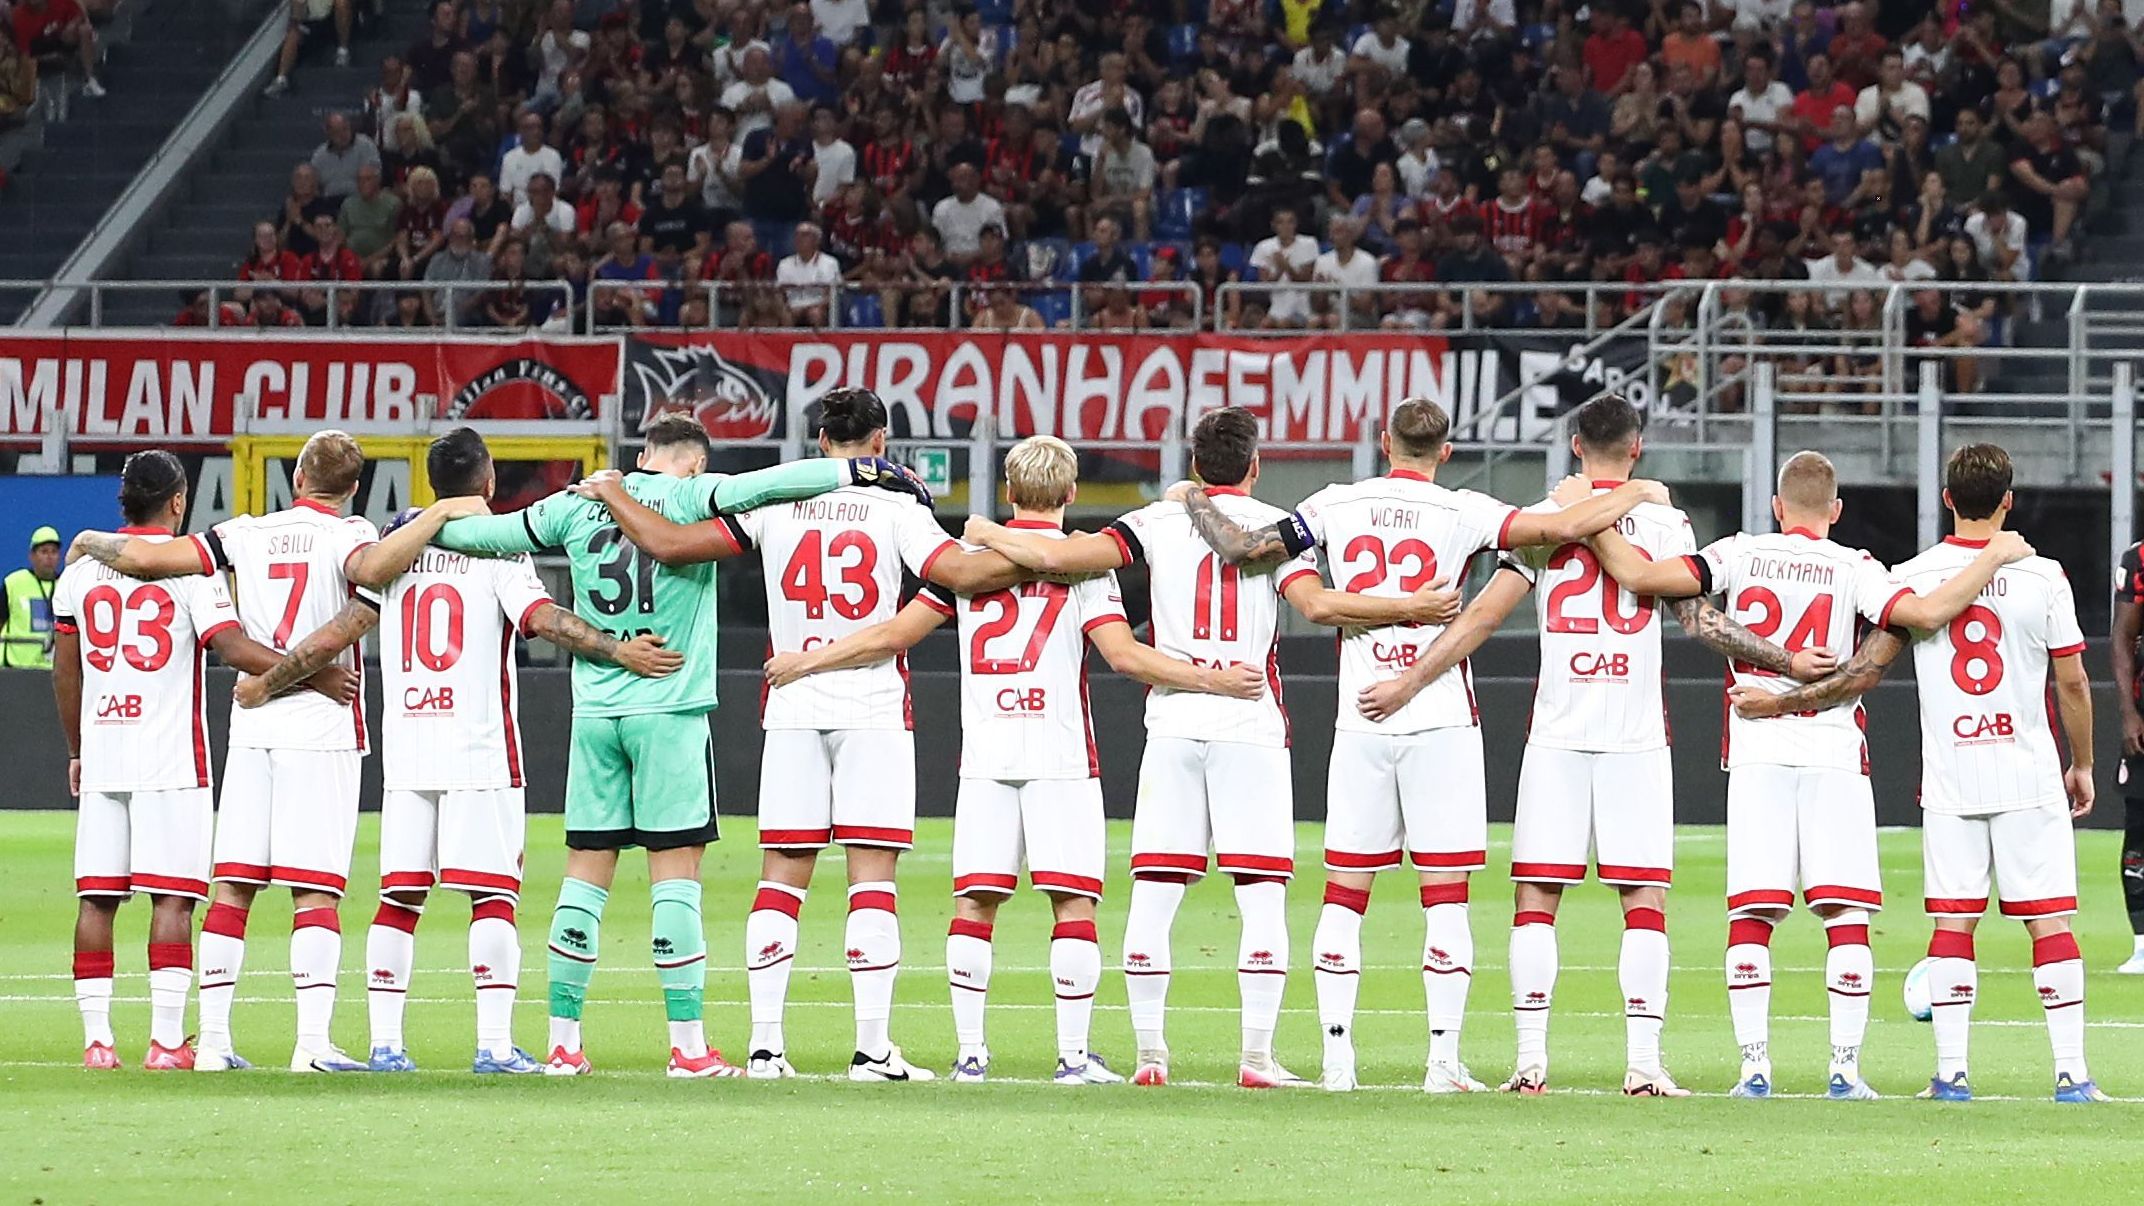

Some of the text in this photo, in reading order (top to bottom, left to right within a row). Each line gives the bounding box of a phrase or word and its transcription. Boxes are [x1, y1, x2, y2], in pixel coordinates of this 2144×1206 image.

[0, 357, 417, 434] MILAN CLUB
[792, 500, 869, 522] NIKOLAOU
[1370, 507, 1420, 530] VICARI
[267, 562, 308, 649] 7
[588, 527, 655, 615] 31
[780, 529, 879, 620] 43
[1193, 551, 1238, 641] 11
[1343, 534, 1437, 628] 23
[1547, 542, 1654, 635] 20
[1750, 556, 1834, 586] DICKMANN
[83, 583, 175, 672] 93
[401, 582, 464, 673] 10
[969, 581, 1069, 674] 27
[1372, 641, 1418, 667] CAB
[1569, 652, 1629, 676] CAB
[1735, 586, 1833, 678] 24
[1948, 604, 2004, 696] 8
[404, 687, 454, 710] CAB
[996, 687, 1045, 711] CAB
[1953, 713, 2014, 739] CAB
